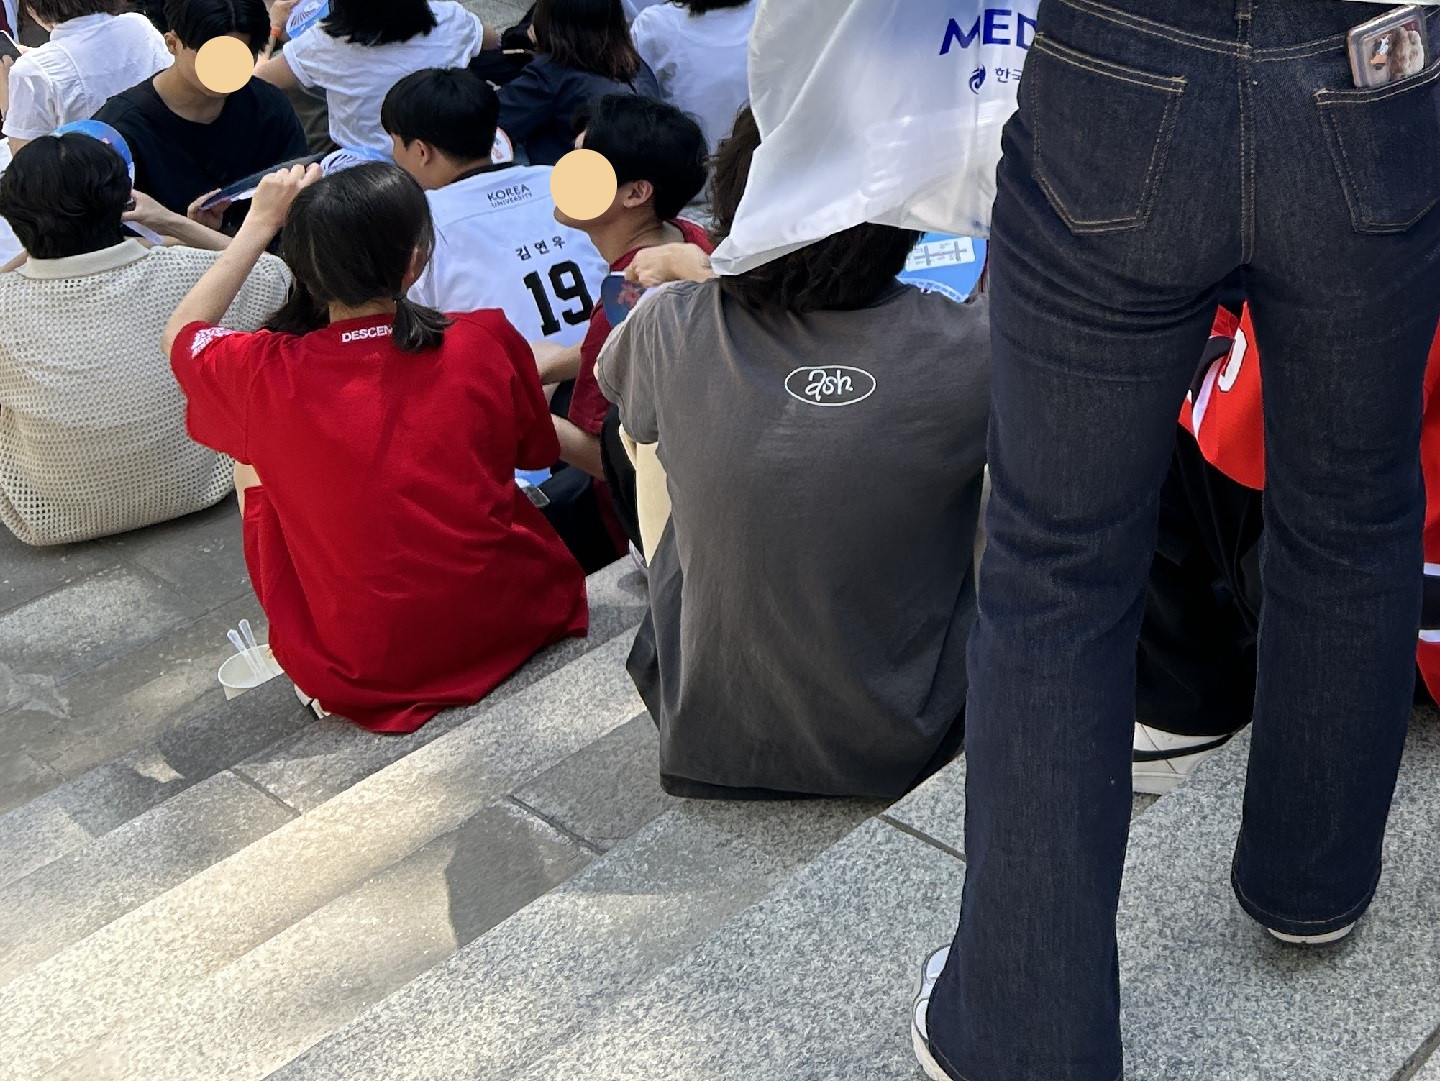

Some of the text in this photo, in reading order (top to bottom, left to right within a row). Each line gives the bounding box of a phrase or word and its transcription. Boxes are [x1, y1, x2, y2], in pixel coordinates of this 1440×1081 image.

[487, 183, 530, 203] KOREA
[491, 192, 533, 208] UNIVERSITY
[523, 259, 594, 338] 19
